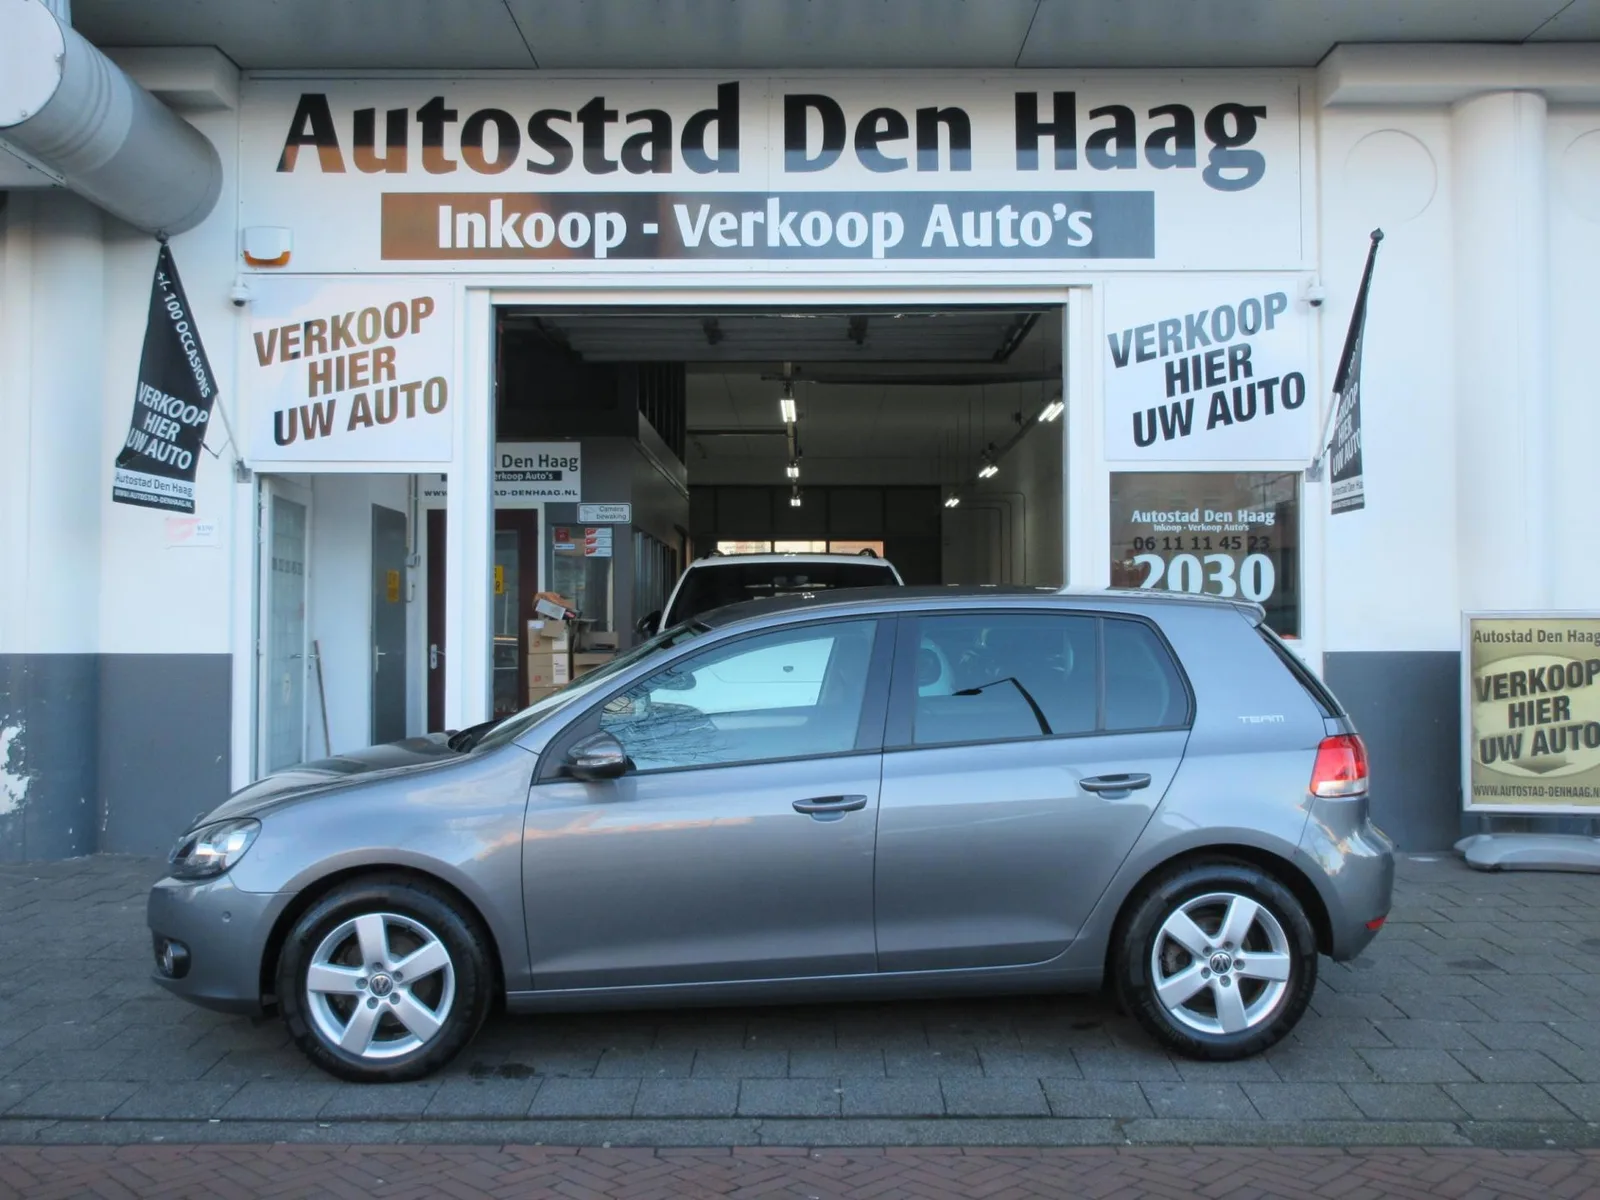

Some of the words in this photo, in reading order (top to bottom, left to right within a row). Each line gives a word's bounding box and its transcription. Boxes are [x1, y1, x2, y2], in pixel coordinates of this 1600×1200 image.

[276, 81, 739, 175] Autostad
[784, 94, 972, 173] Den
[1015, 91, 1267, 192] Haag
[438, 199, 627, 258] Inkoop
[673, 198, 905, 259] Verkoop
[921, 203, 1093, 248] Auto's
[164, 292, 184, 320] 100
[176, 321, 211, 398] OCCASIONS
[253, 296, 435, 367] VERKOOP
[1107, 291, 1288, 369] VERKOOP
[308, 345, 397, 398] HIER
[1165, 342, 1254, 398] HIER
[138, 381, 209, 427] VERKOOP
[274, 399, 336, 447] UW
[346, 376, 448, 432] AUTO
[1133, 398, 1195, 448] UW
[1206, 371, 1306, 431] AUTO
[126, 427, 149, 453] UW
[144, 439, 193, 470] AUTO
[143, 411, 181, 442] HIER
[115, 471, 152, 488] Autostad
[154, 478, 171, 492] Den
[172, 483, 193, 498] Haag
[495, 471, 524, 481] erkoop
[525, 471, 553, 480] Auto's
[502, 454, 533, 468] Den
[538, 454, 578, 471] Haag
[1131, 508, 1199, 523] Autostad
[1204, 510, 1233, 523] Den
[1238, 509, 1275, 526] Haag
[1154, 523, 1182, 533] Inkoop
[1188, 523, 1222, 533] Verkoop
[1223, 523, 1249, 532] Auto's
[1133, 536, 1156, 550] 06
[1163, 536, 1183, 550] 11
[1191, 536, 1212, 550] 11
[1219, 536, 1242, 550] 45
[1248, 536, 1270, 549] 23
[1133, 553, 1276, 602] 2030
[1473, 629, 1533, 643] Autostad
[1537, 630, 1563, 643] Den
[1567, 630, 1600, 647] Haag
[1474, 658, 1600, 702] VERKOOP
[1238, 714, 1285, 724] TEAM
[1508, 695, 1571, 729] HIER
[1479, 732, 1522, 765] UW
[1530, 721, 1600, 757] AUTO
[1473, 785, 1600, 798] WWW.AUTOSTAD-DENHAAG.N
